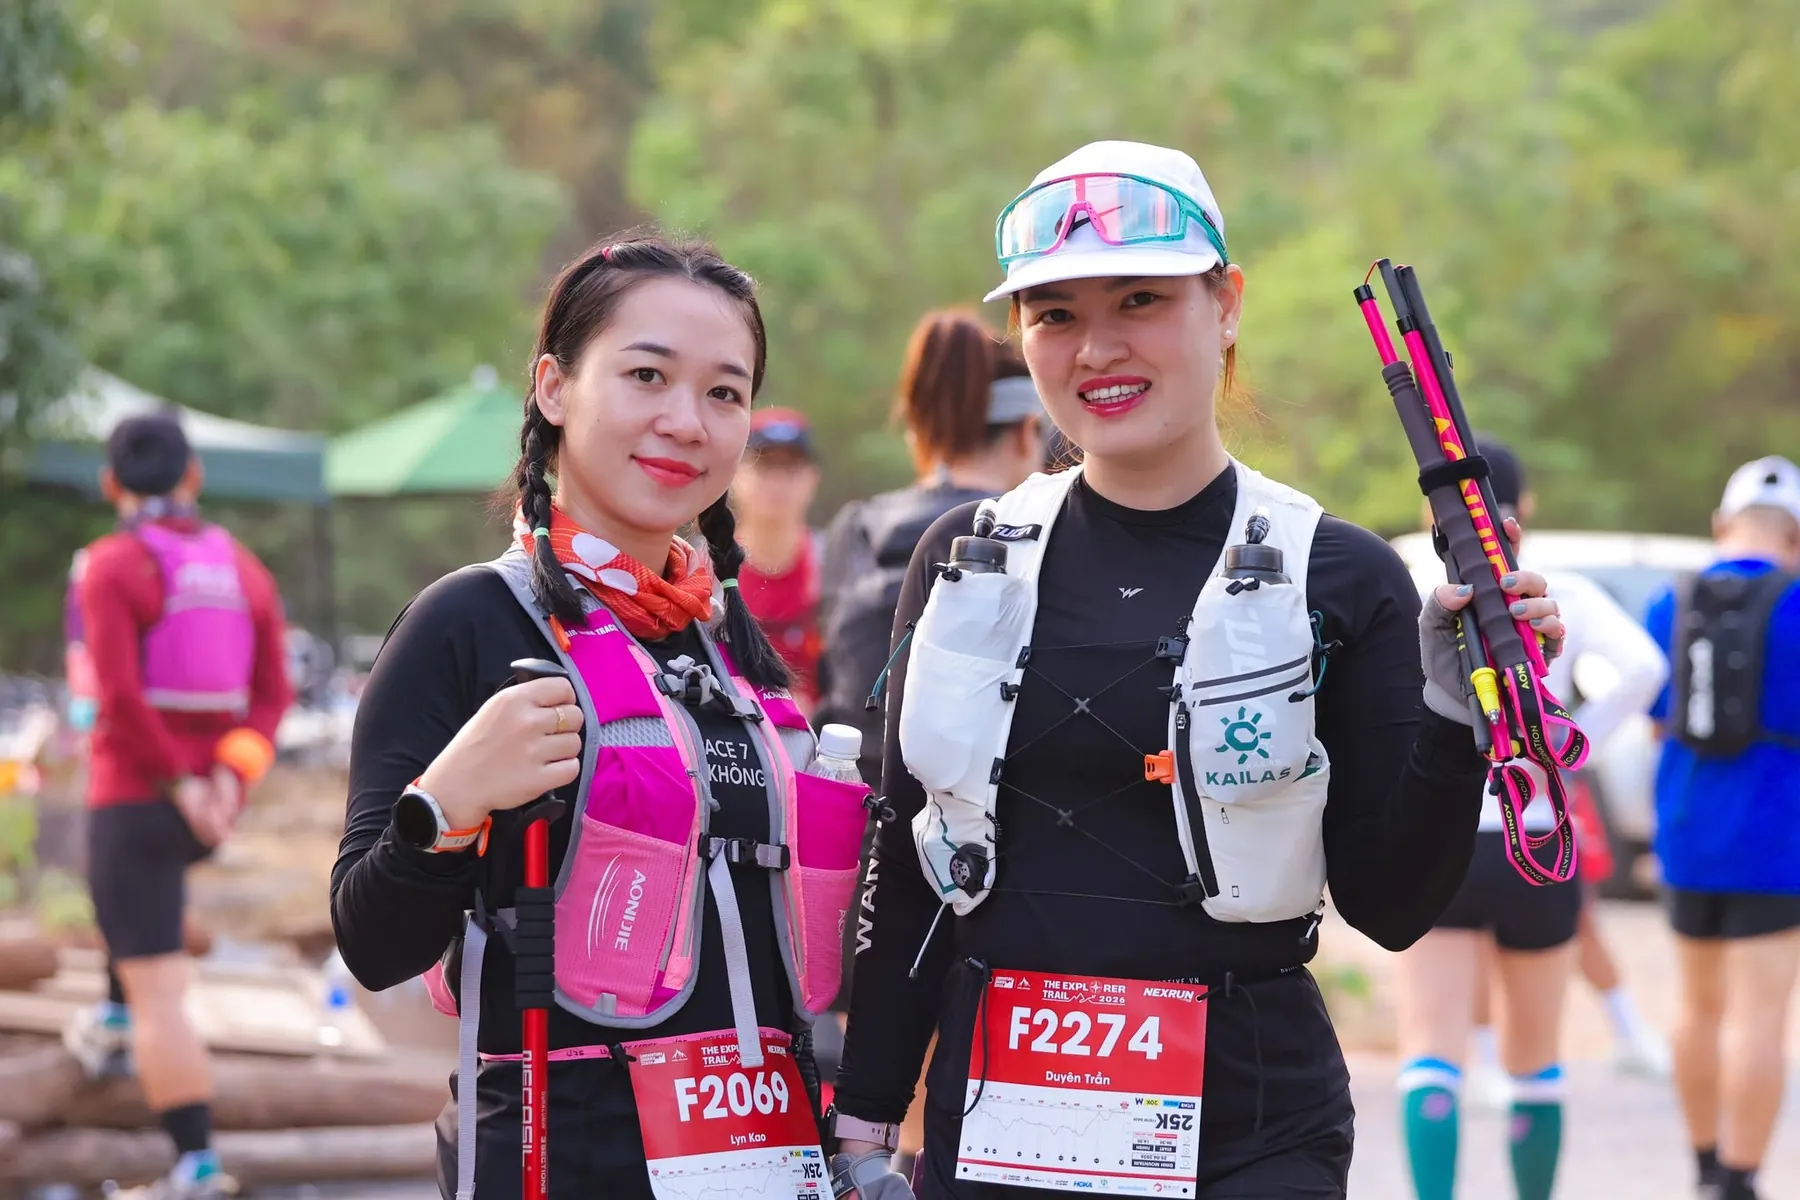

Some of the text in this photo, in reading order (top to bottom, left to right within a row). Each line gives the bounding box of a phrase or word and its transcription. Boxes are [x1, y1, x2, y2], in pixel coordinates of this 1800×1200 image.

[705, 739, 748, 759] ACE 7
[708, 762, 766, 787] KHÔNG
[1206, 767, 1291, 785] KAILAS
[1503, 803, 1517, 845] AONIJIE
[1515, 851, 1543, 881] BEYOND
[614, 868, 646, 951] AONIJIE
[1044, 980, 1061, 989] THE
[1143, 987, 1194, 999] NEXRUN
[1043, 990, 1125, 1003] TRAIL 2026
[1009, 1006, 1163, 1060] F2274
[701, 1044, 739, 1055] THE EXPL
[702, 1055, 728, 1064] TRAIL
[1045, 1070, 1111, 1085] Duyên Trần
[674, 1071, 789, 1122] F2069
[1155, 1113, 1193, 1131] 25K
[730, 1132, 766, 1146] Lyn Kao
[802, 1163, 822, 1179] 25K
